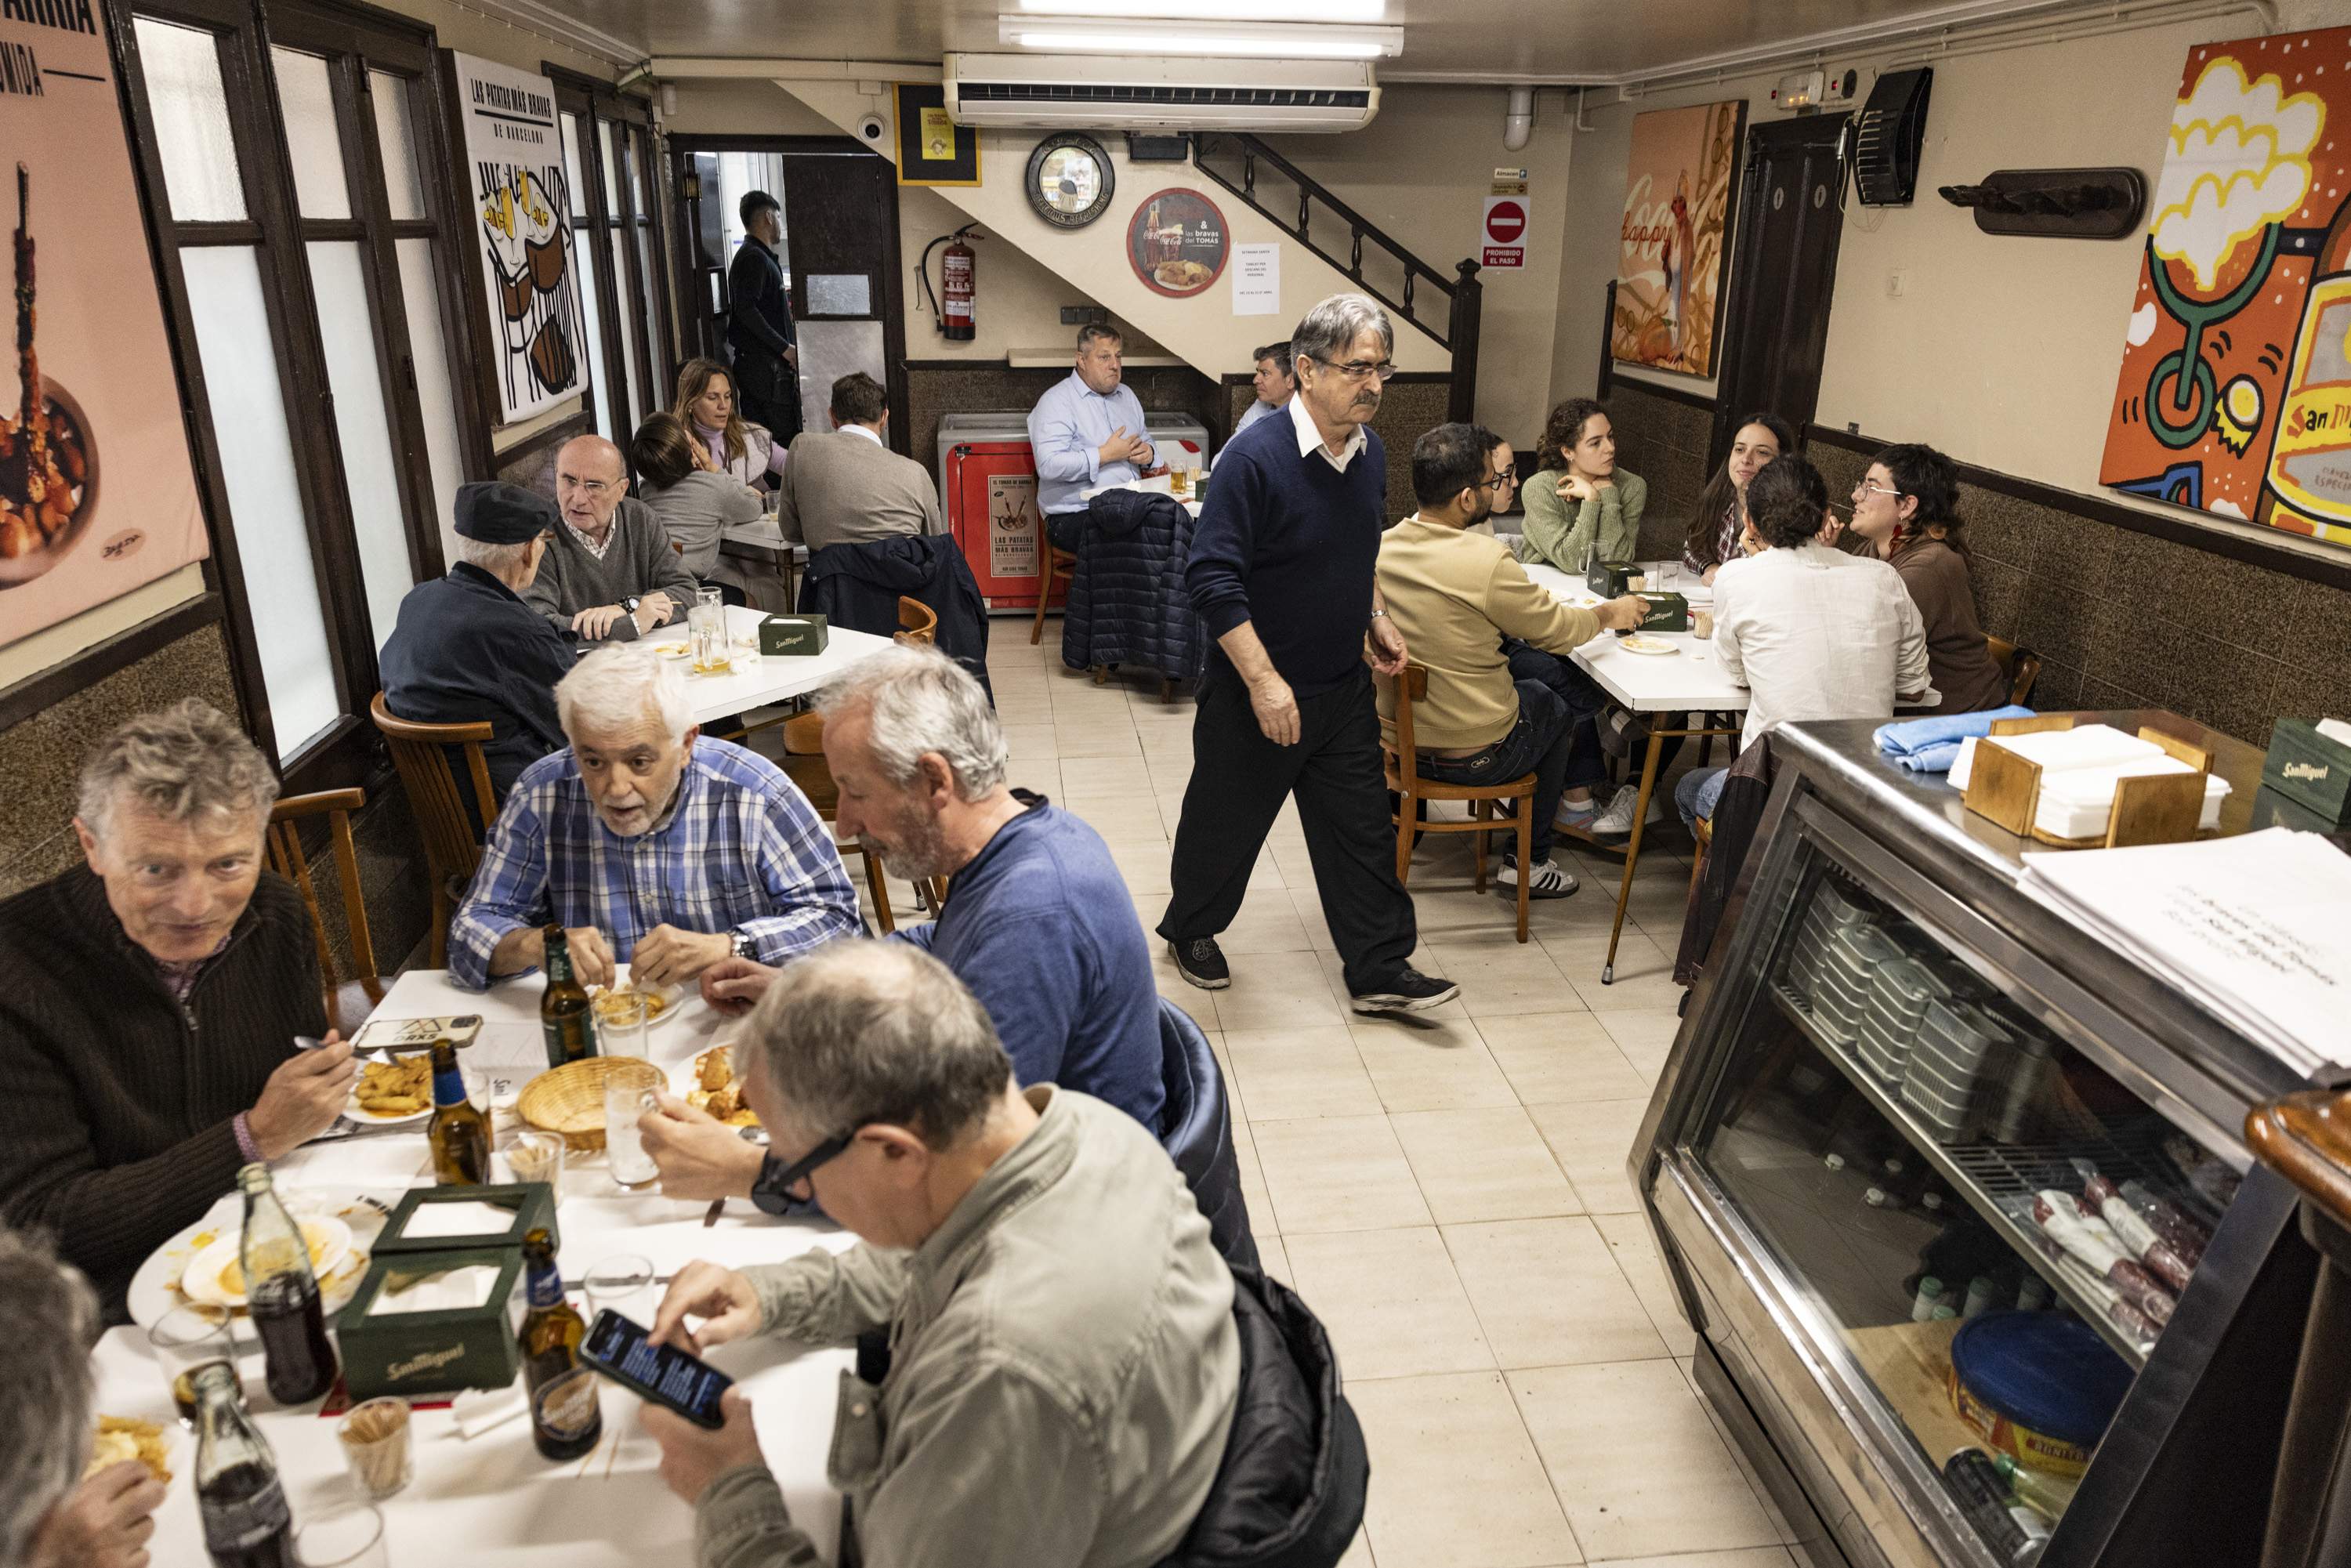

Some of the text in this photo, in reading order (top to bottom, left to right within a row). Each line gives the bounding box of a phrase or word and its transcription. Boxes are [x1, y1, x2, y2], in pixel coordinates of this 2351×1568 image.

[0, 41, 44, 96] MIDA
[471, 78, 552, 119] LAS PATATAS MÁS BRAVAS
[506, 126, 544, 144] BARCELONA
[1201, 220, 1208, 230] &
[1621, 211, 1672, 255] happy
[2287, 404, 2328, 439] San
[1645, 610, 1673, 623] SanMiguel
[775, 633, 804, 650] SanMiguel
[2281, 762, 2329, 782] SanMiguel
